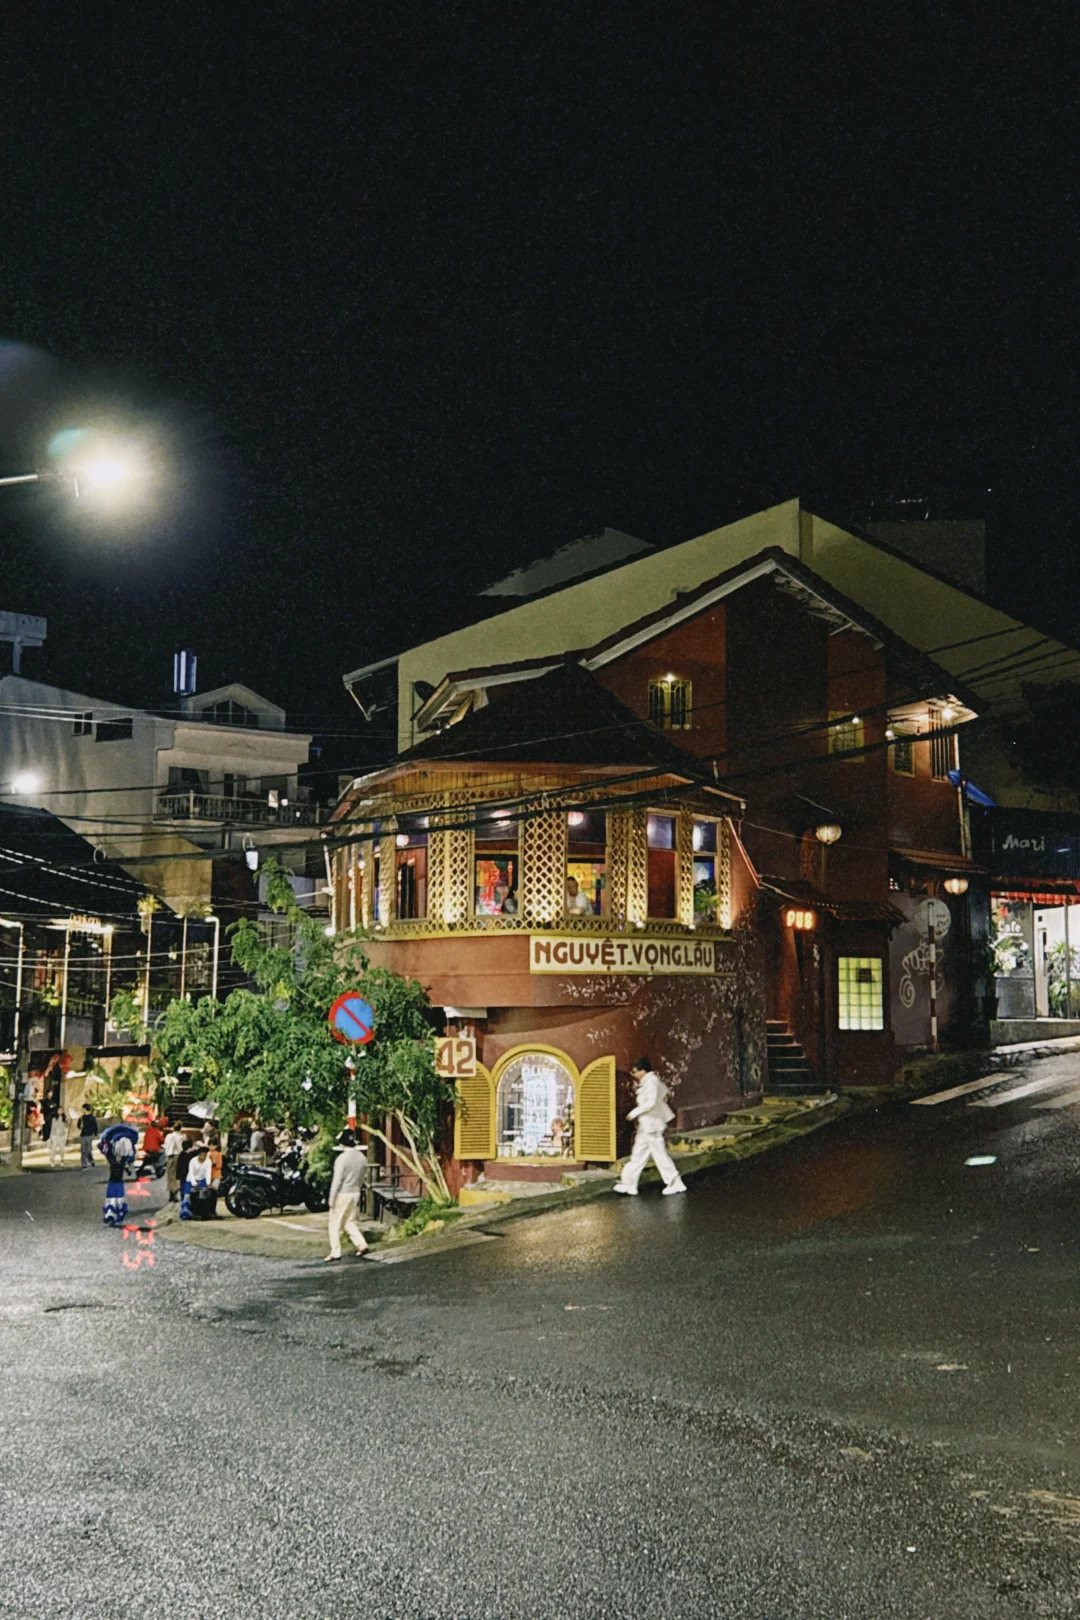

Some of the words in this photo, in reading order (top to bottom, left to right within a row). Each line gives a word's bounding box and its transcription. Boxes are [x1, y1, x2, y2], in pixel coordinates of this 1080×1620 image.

[1002, 834, 1045, 851] Mari
[786, 910, 813, 929] PUB
[998, 920, 1022, 933] Cafe
[437, 1040, 474, 1074] 42
